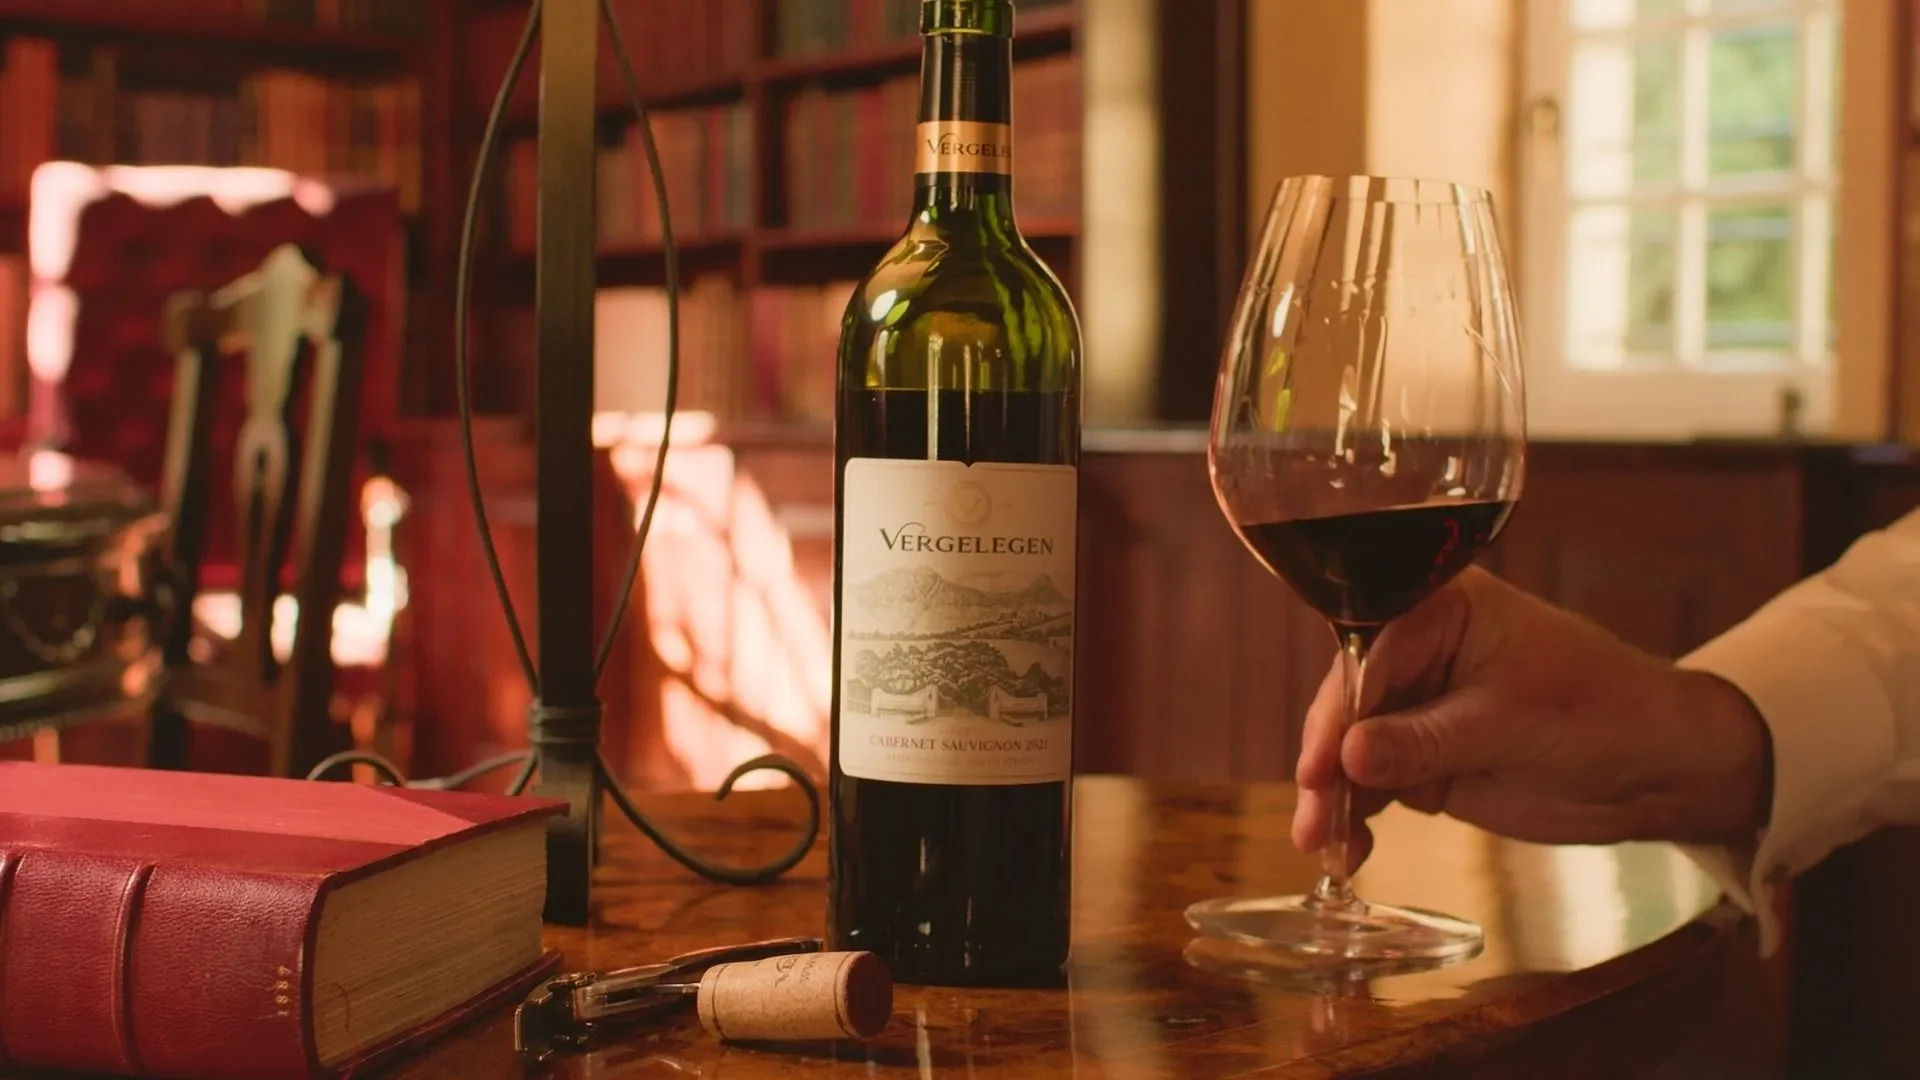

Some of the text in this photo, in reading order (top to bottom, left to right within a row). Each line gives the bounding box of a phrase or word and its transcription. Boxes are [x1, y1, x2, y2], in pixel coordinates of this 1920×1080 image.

[879, 521, 1053, 555] VERGELEGEN
[869, 735, 937, 750] CABERNET
[941, 738, 1022, 752] SAUVIGNON
